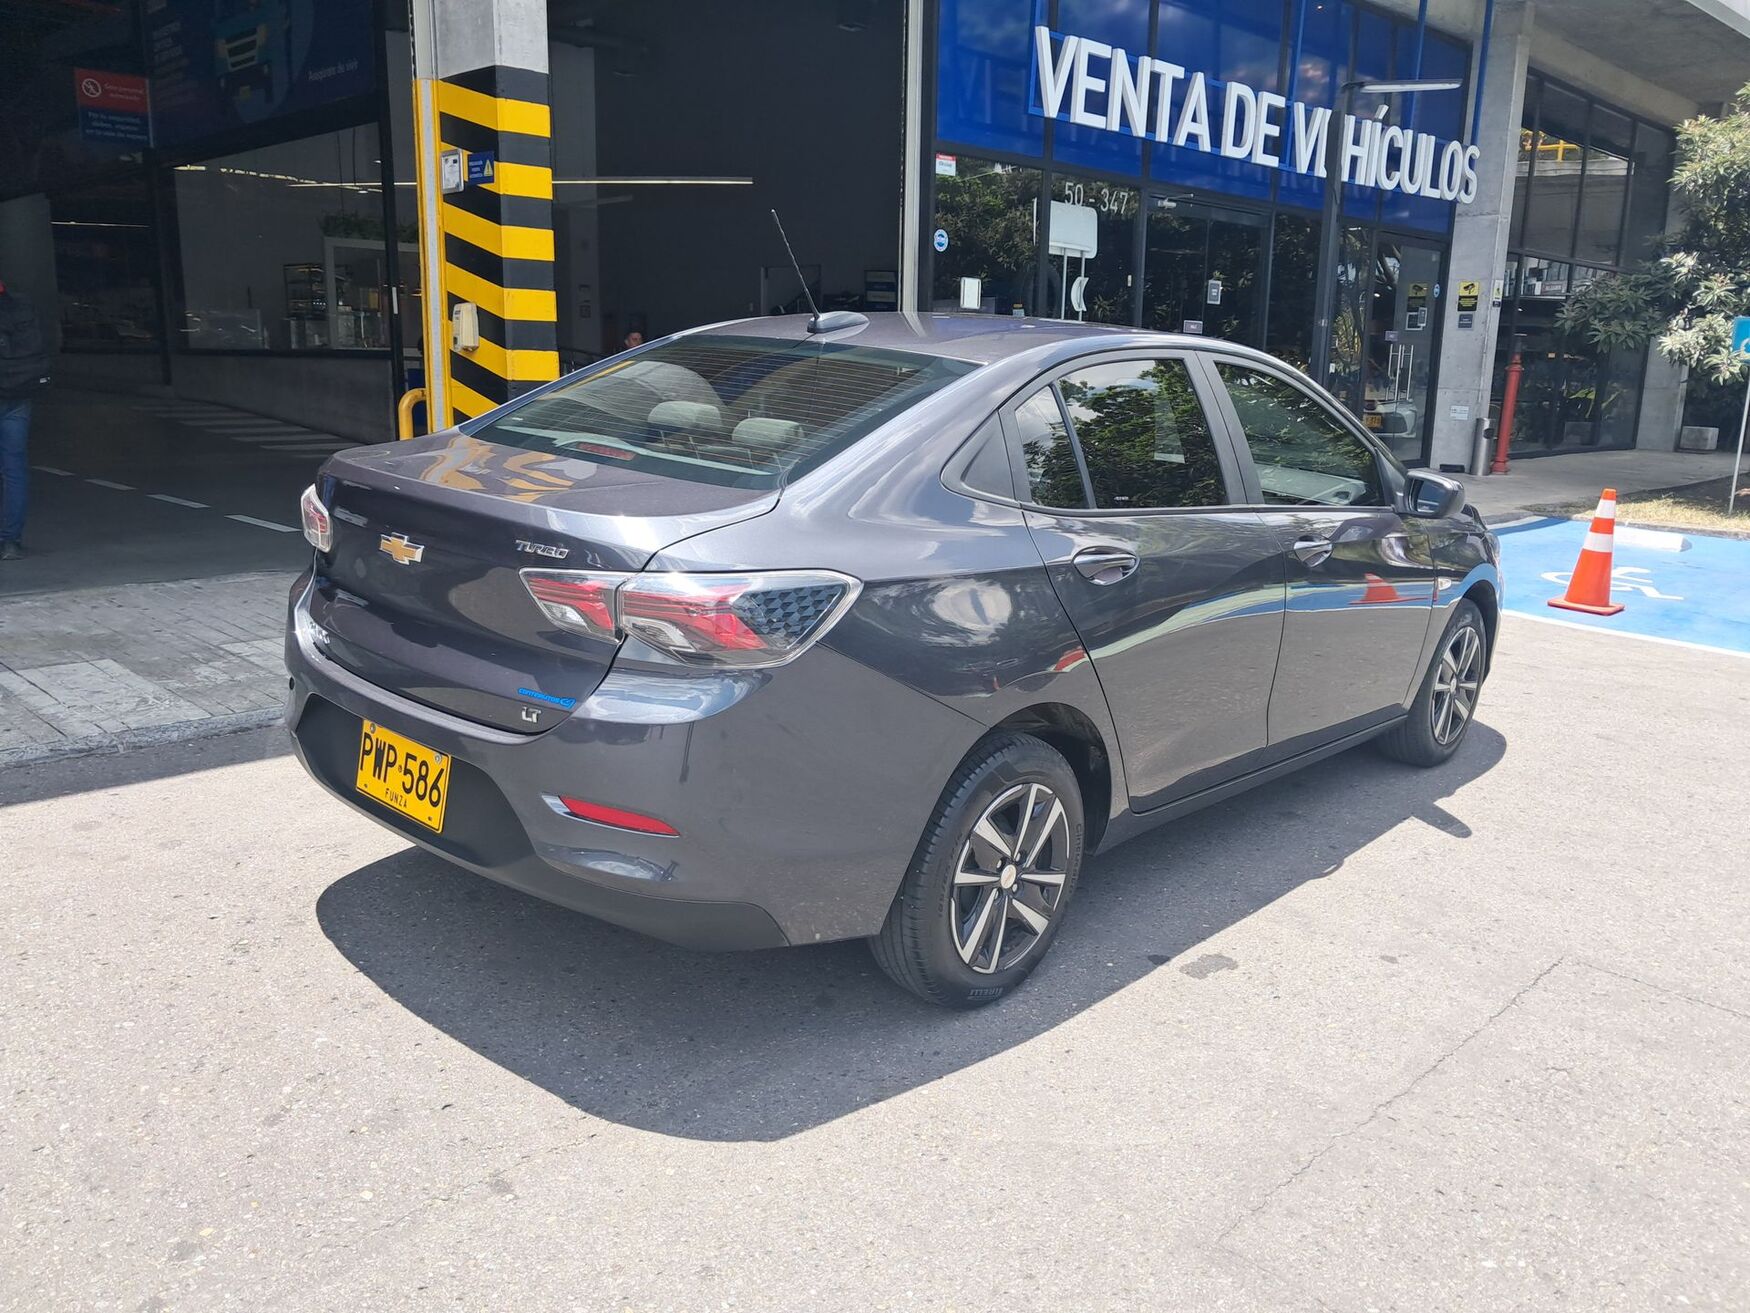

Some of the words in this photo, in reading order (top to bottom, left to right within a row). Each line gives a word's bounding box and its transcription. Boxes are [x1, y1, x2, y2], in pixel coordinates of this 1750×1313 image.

[1034, 25, 1212, 153] VENTA
[1220, 81, 1287, 168] DE
[1064, 181, 1084, 206] 50
[1100, 188, 1129, 214] 347
[515, 539, 569, 560] TURBO
[521, 704, 542, 723] LT
[385, 787, 408, 809] FUNZA
[968, 986, 1004, 999] PIRELLI
